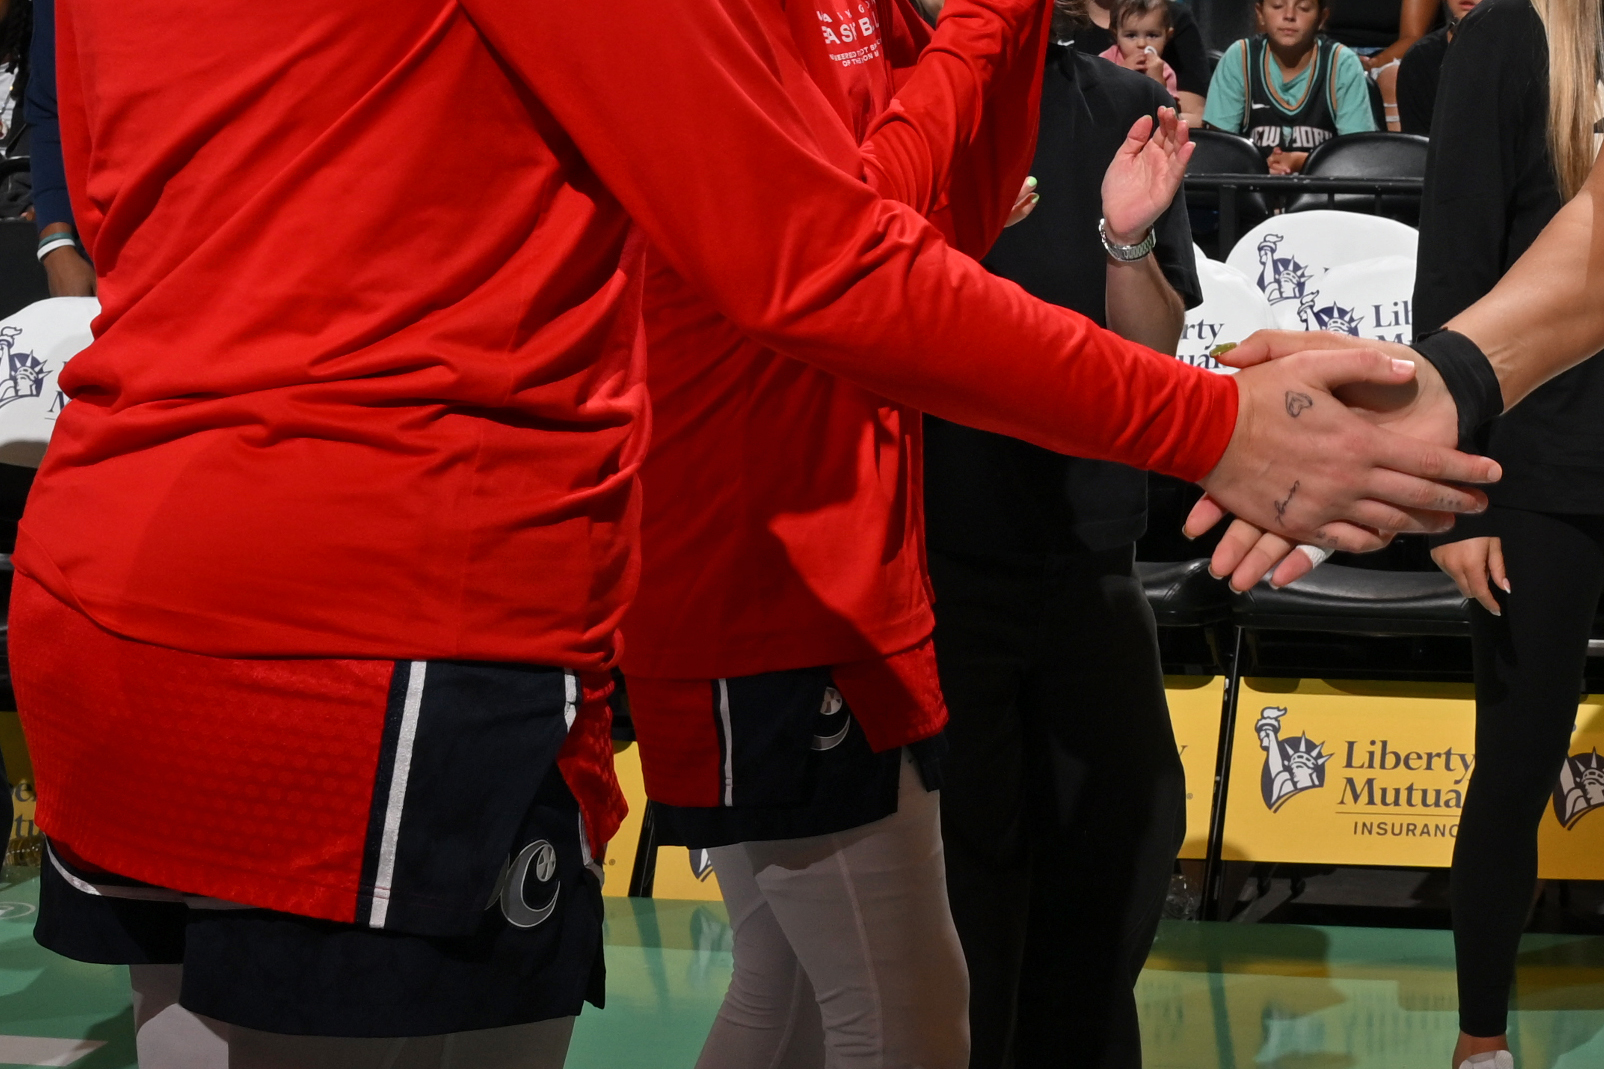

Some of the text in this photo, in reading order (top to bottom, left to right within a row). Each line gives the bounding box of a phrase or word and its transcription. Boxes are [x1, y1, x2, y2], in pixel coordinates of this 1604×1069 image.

[1342, 739, 1476, 785] Liberty
[1337, 776, 1463, 809] Mutua
[1353, 821, 1460, 838] INSURANC
